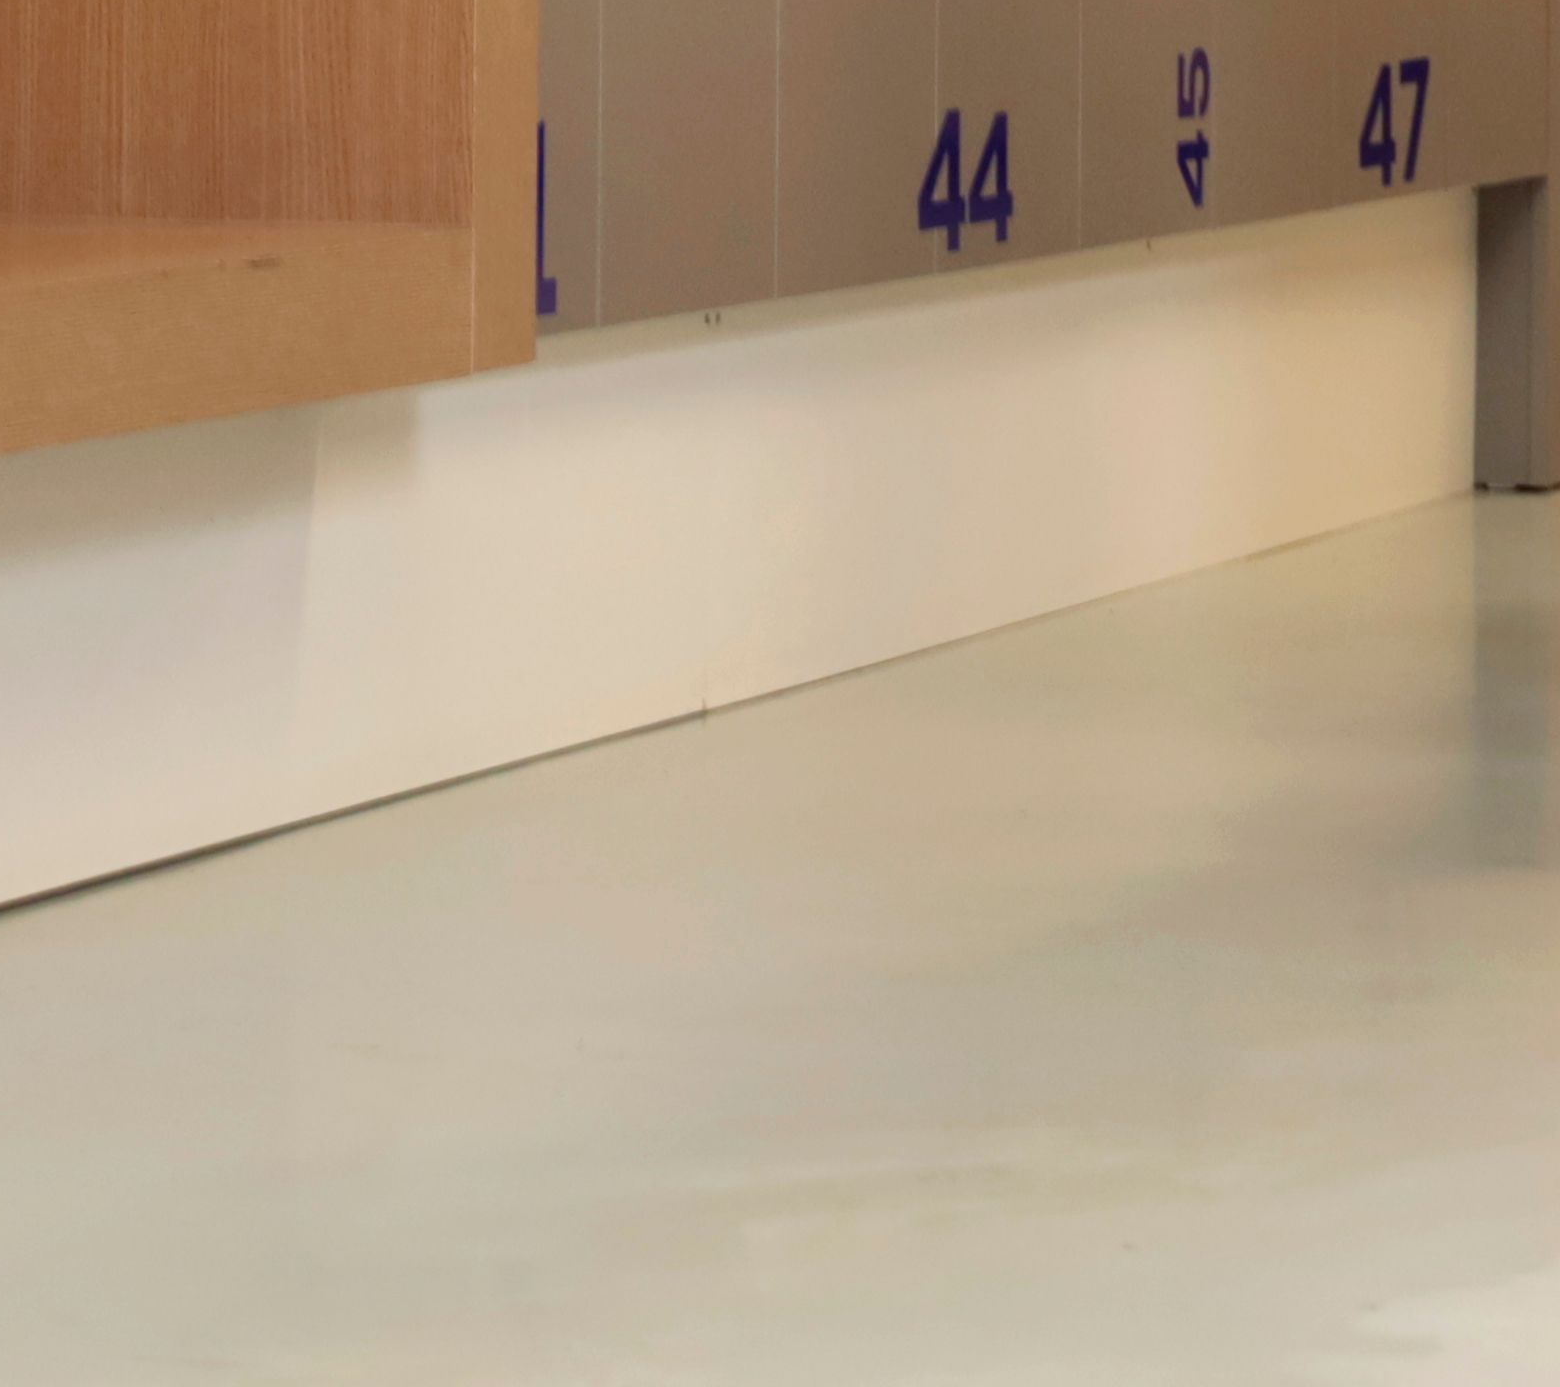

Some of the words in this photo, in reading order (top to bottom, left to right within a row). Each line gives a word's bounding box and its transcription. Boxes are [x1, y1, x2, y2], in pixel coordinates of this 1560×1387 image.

[918, 108, 1014, 252] 44
[1176, 46, 1212, 209] 45
[1358, 56, 1431, 188] 47
